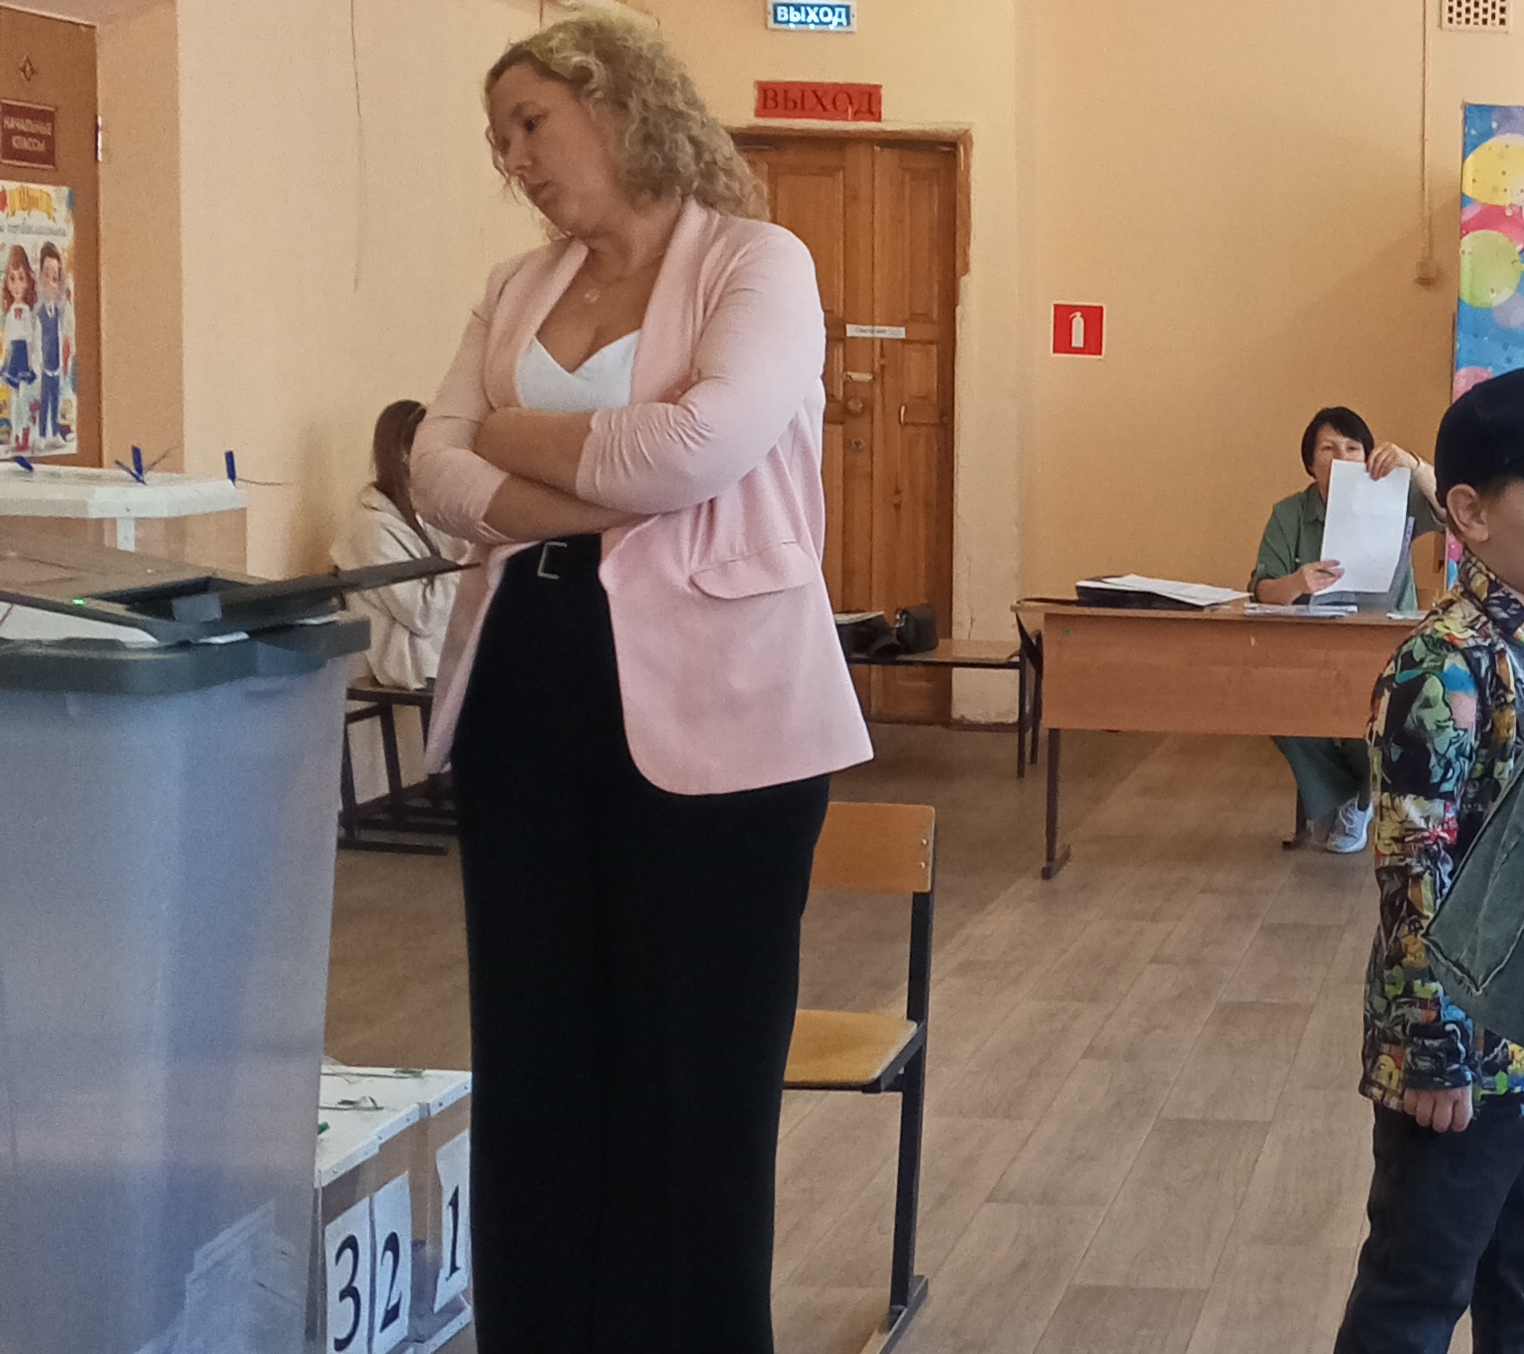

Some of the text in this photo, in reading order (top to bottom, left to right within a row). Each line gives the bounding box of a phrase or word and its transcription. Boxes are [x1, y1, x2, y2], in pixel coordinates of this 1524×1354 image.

[776, 5, 847, 27] ВЫХОД
[761, 87, 875, 116] ВЫХОД
[379, 1230, 402, 1334] 2
[447, 1185, 461, 1283] 1
[333, 1233, 361, 1353] 3
